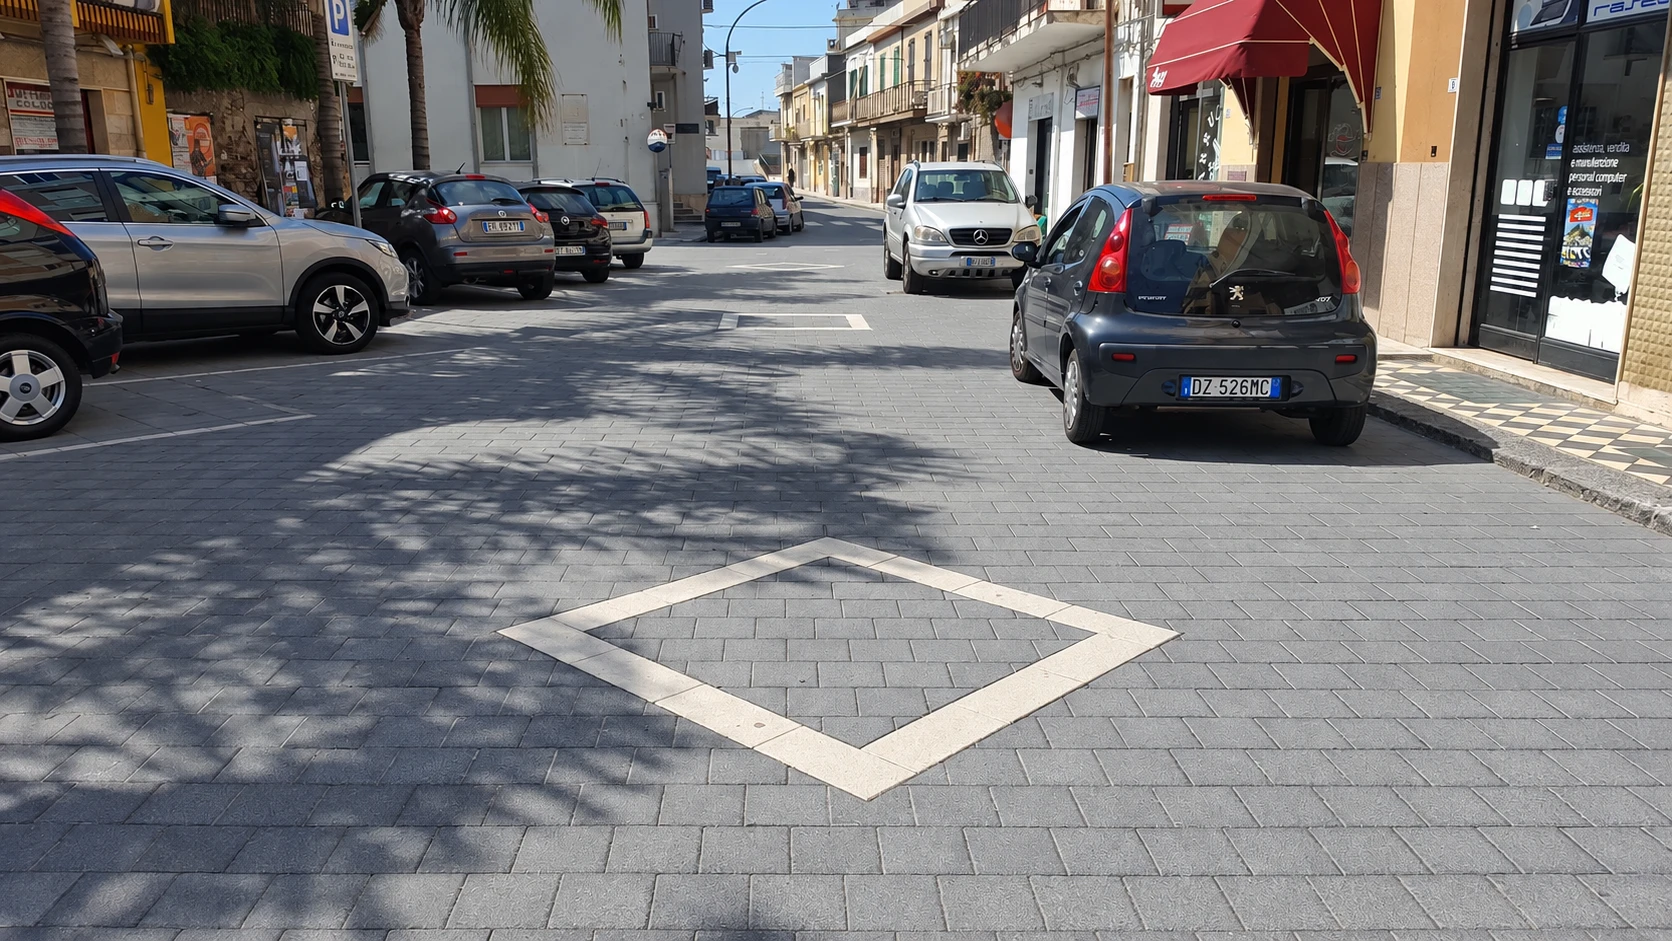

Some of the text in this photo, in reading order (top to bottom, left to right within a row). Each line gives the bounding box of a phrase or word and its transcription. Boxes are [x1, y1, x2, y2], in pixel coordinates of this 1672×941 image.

[332, 0, 345, 30] P
[1606, 141, 1630, 153] vendita
[1568, 170, 1628, 184] personal computer
[1191, 378, 1213, 396] DZ
[1219, 378, 1270, 396] 526MC
